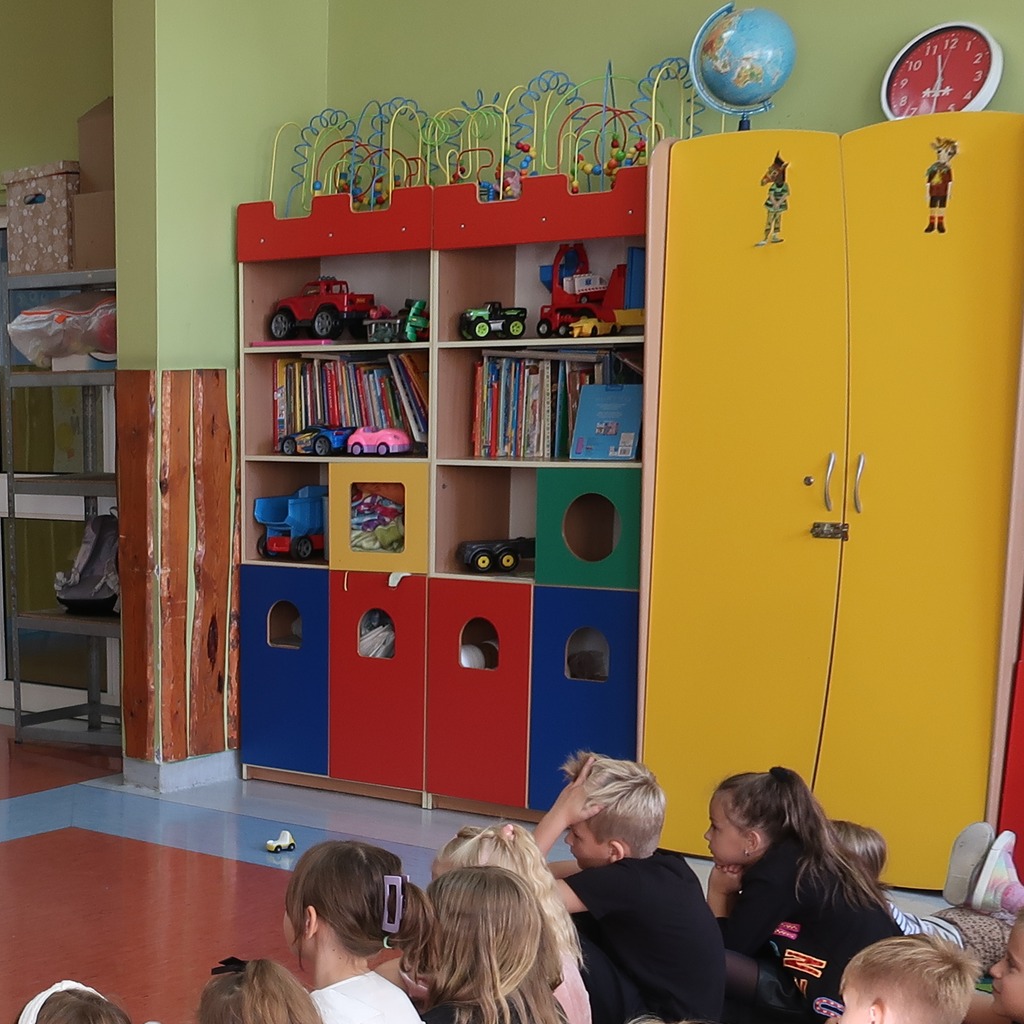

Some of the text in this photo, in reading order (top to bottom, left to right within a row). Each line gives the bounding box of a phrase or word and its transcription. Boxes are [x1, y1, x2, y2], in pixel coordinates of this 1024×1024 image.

[925, 44, 938, 56] 11
[943, 38, 959, 50] 12
[965, 40, 972, 52] 1
[973, 52, 983, 64] 2
[907, 60, 922, 72] 10
[973, 70, 983, 82] 3
[899, 78, 909, 89] 9
[899, 95, 908, 106] 8
[963, 90, 973, 100] 4
